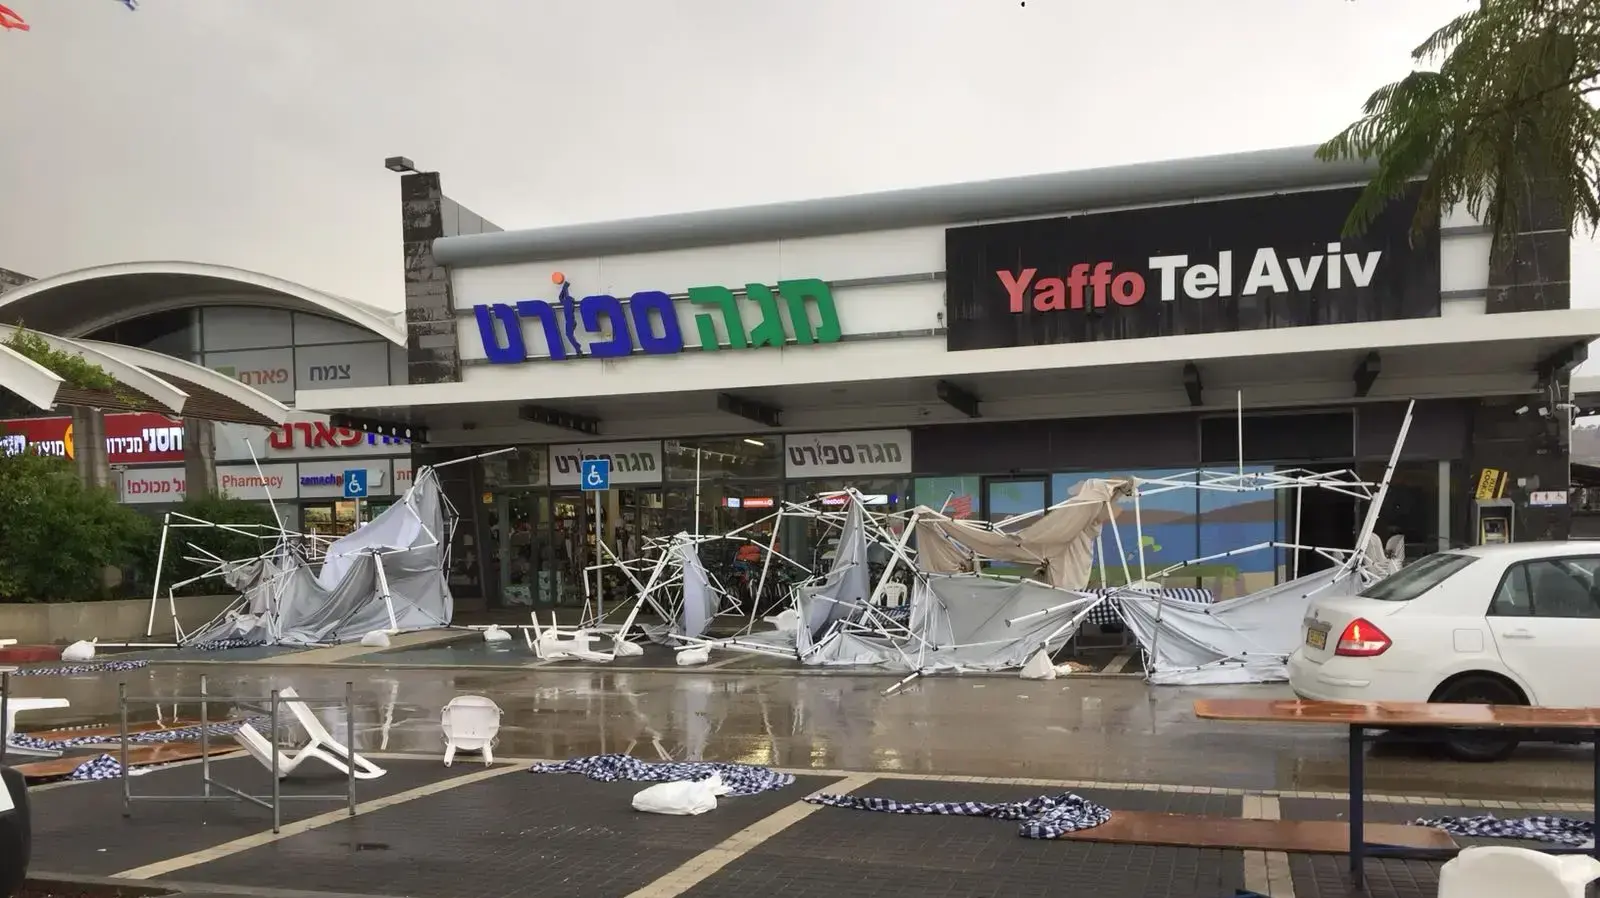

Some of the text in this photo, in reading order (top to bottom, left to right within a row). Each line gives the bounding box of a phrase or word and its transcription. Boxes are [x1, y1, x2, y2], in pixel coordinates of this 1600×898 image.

[996, 242, 1382, 313] Yaffo Tel Aviv
[473, 278, 842, 364] מגה ספורט
[239, 364, 351, 385] צמח פארם
[142, 427, 184, 452] חסני
[270, 421, 363, 449] פארם
[615, 452, 656, 473] מגה
[788, 441, 903, 466] מגה ספורט
[222, 474, 284, 489] Pharmacy
[300, 473, 344, 488] zamachp
